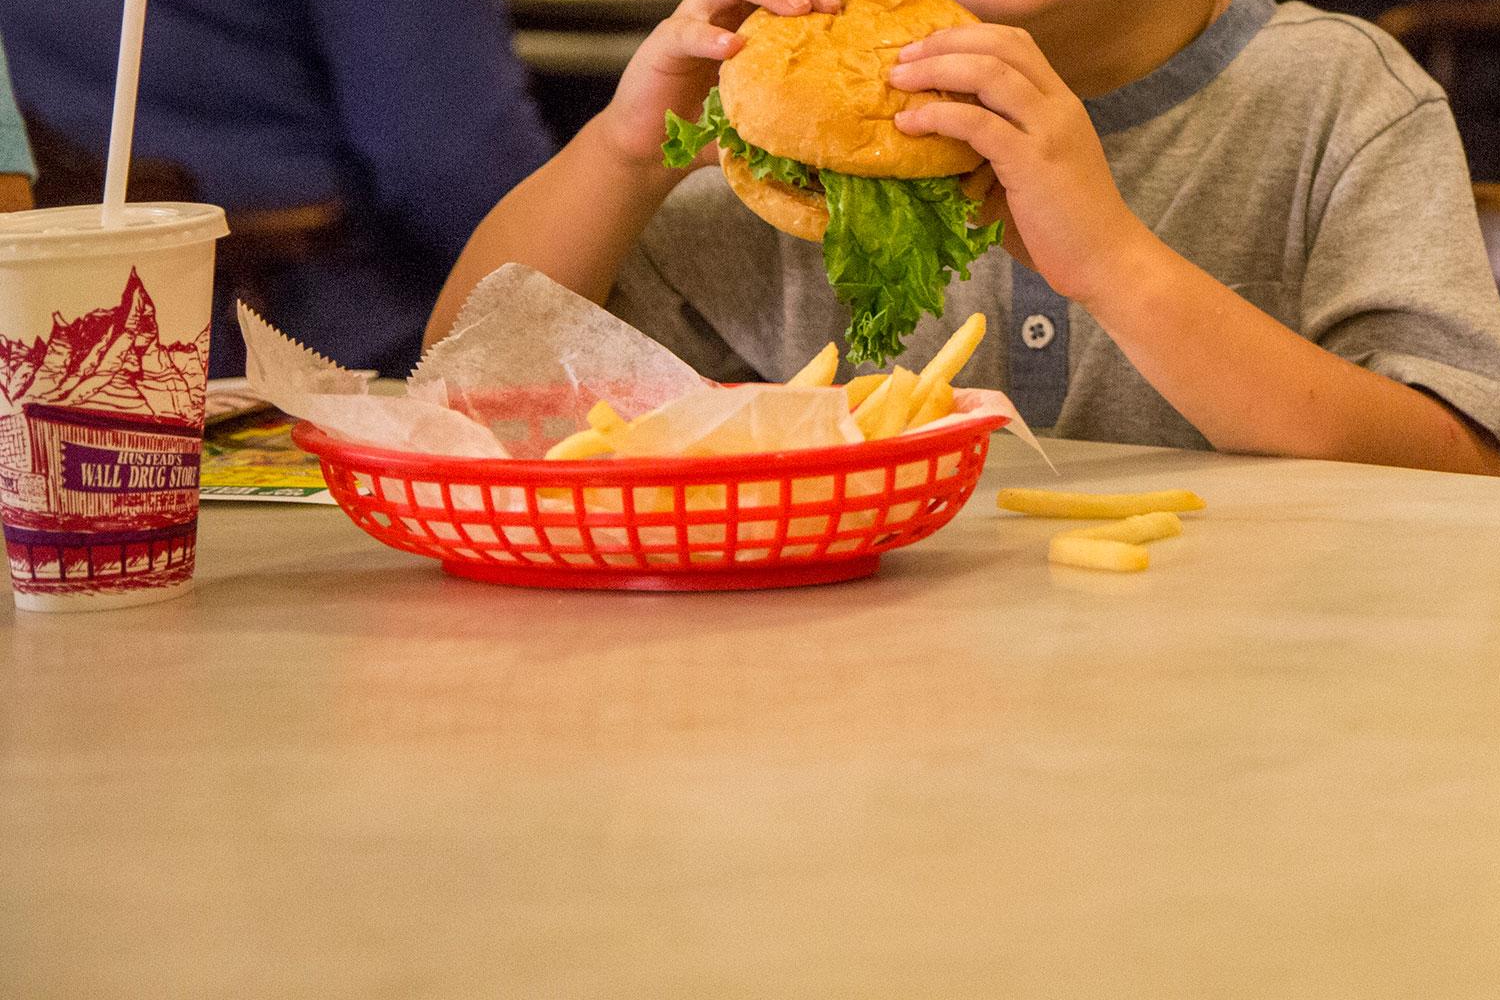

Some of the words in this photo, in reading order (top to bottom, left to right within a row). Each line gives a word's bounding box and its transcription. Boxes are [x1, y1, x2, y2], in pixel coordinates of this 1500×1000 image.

[117, 452, 182, 466] HUSTEAD'S
[81, 462, 121, 488] WALL
[128, 464, 166, 488] DRUG
[169, 466, 198, 487] STORE
